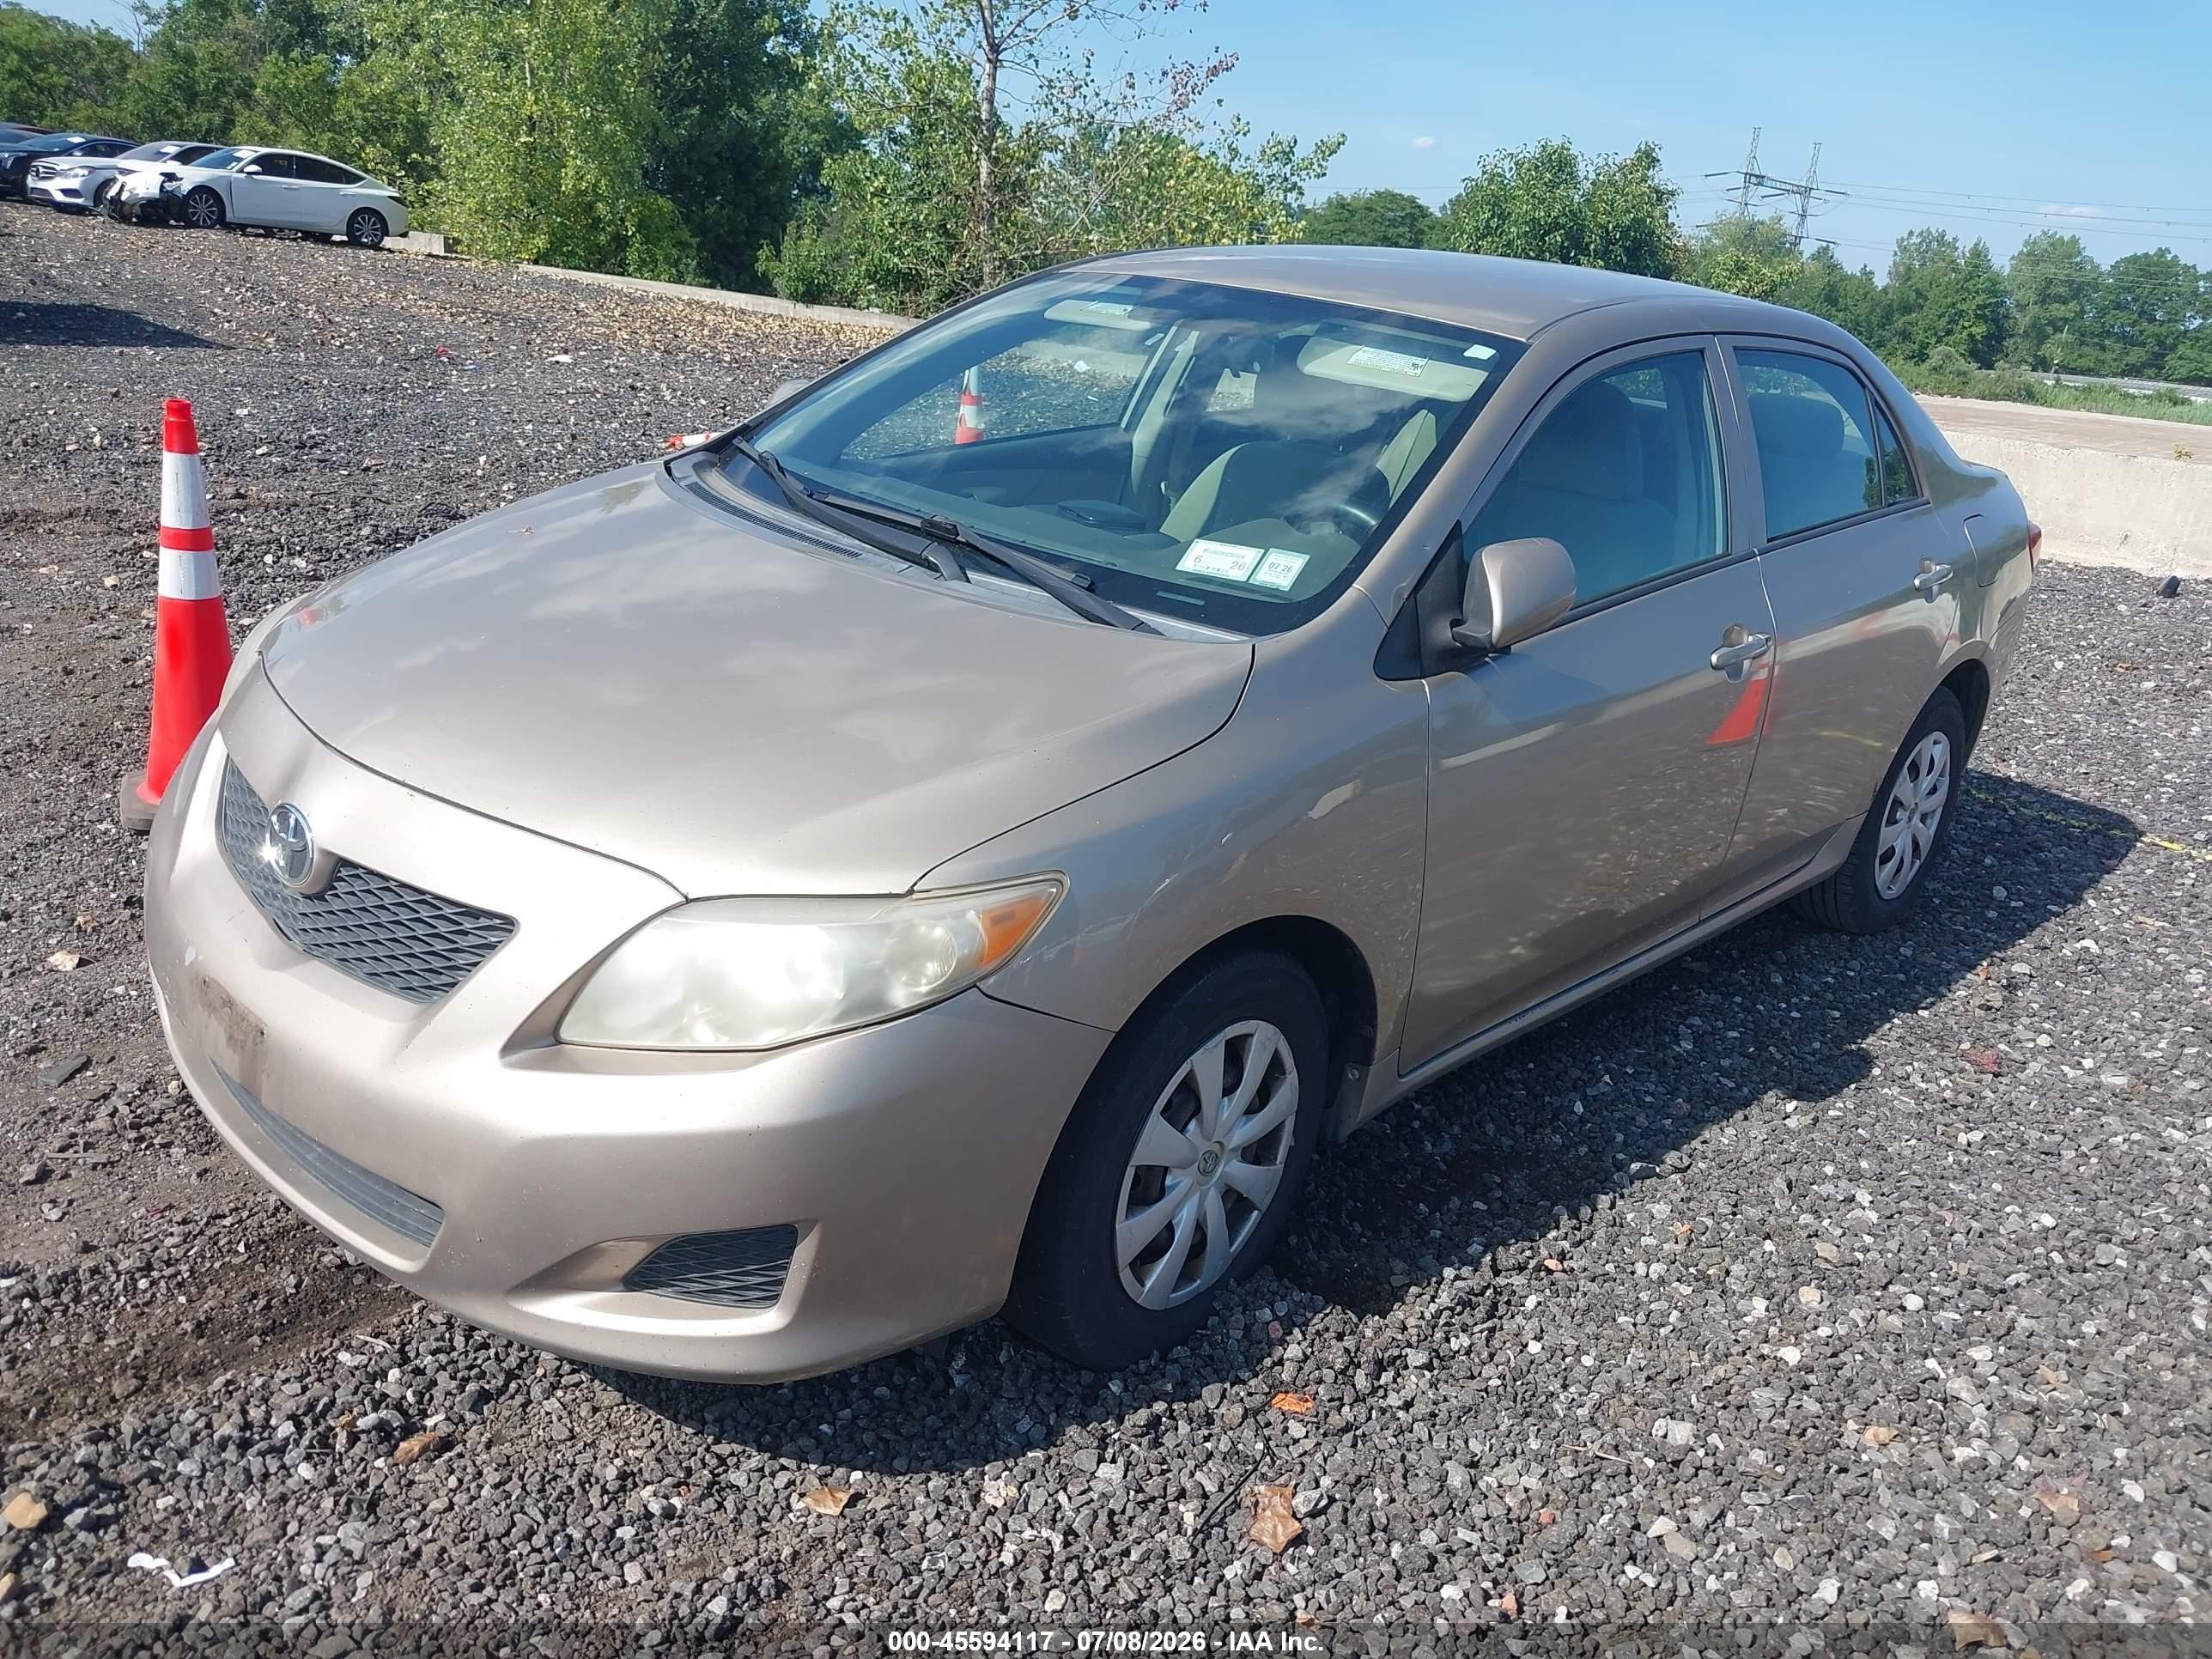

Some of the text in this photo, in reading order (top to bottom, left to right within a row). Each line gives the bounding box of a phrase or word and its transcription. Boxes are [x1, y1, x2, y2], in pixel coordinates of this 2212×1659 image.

[1194, 555, 1203, 564] 6
[1230, 561, 1248, 571] 26
[1268, 562, 1293, 573] 07 26
